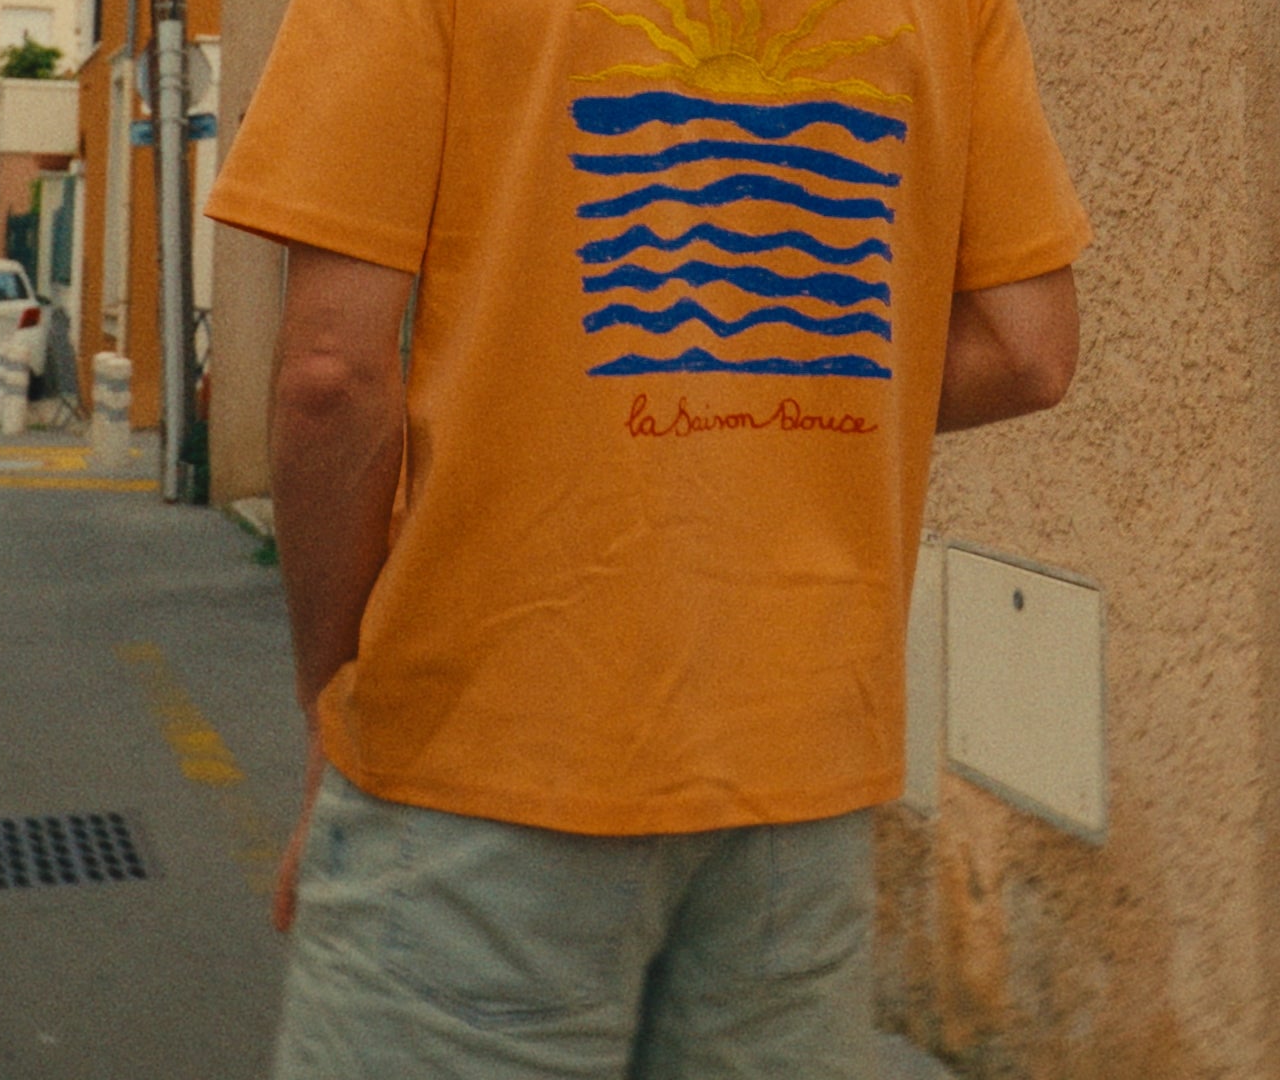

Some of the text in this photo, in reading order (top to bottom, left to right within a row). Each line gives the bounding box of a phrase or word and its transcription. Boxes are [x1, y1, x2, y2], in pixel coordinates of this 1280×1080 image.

[624, 393, 879, 438] la Saison Douce
